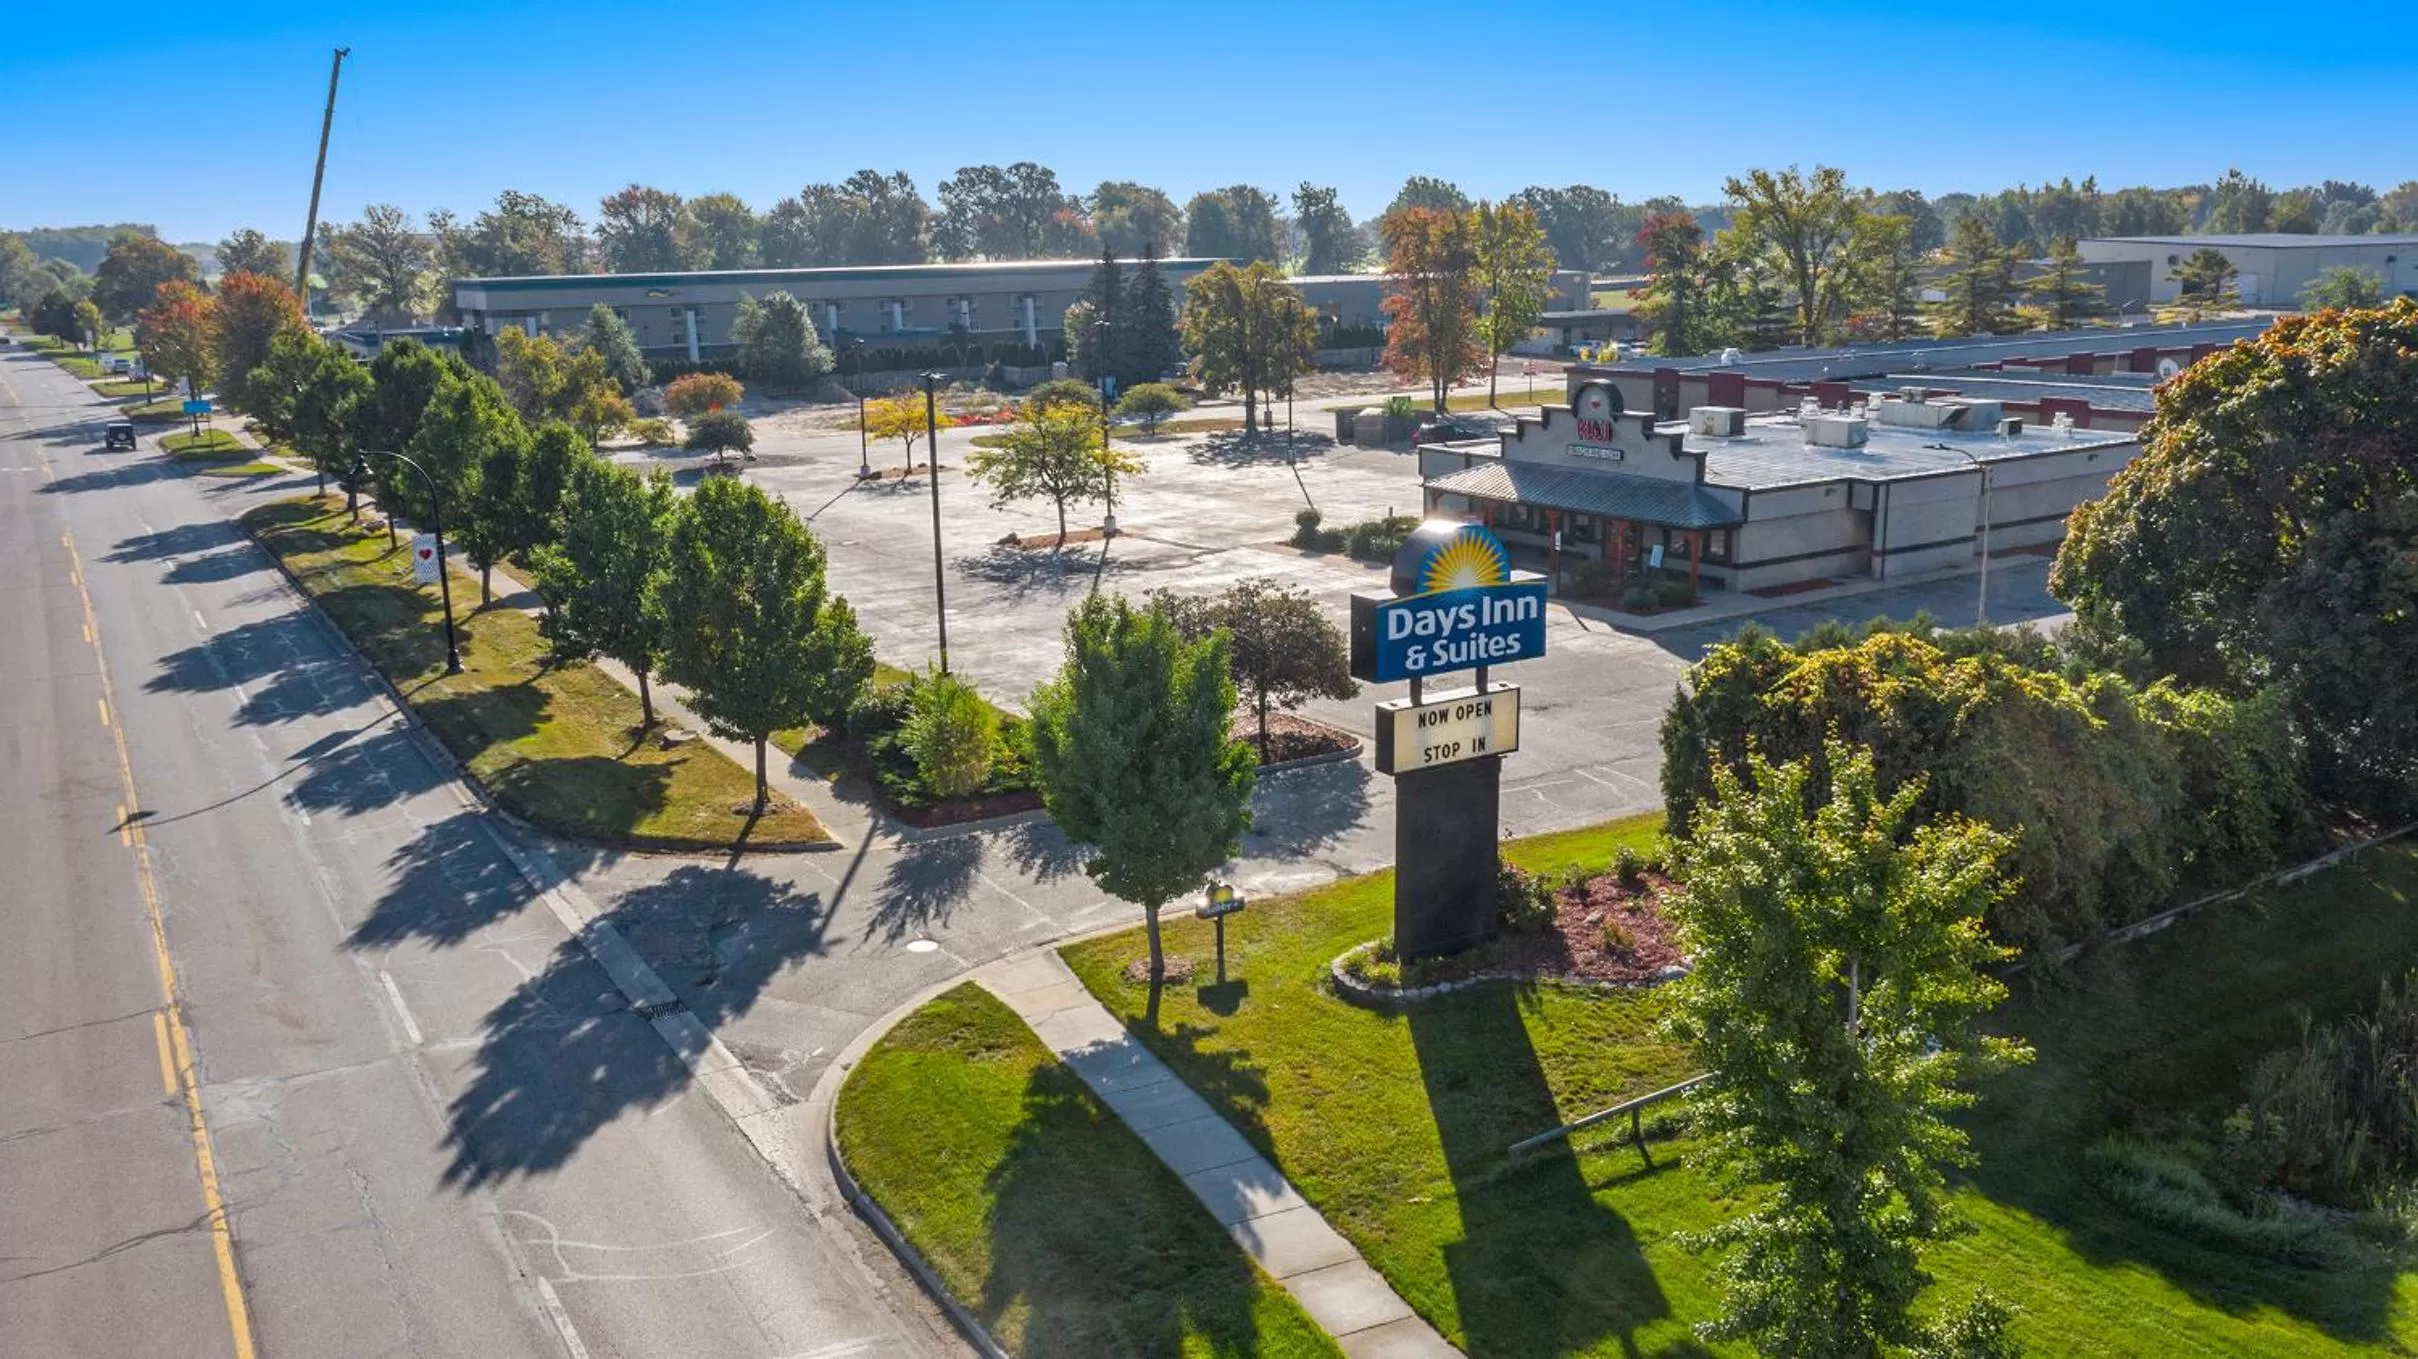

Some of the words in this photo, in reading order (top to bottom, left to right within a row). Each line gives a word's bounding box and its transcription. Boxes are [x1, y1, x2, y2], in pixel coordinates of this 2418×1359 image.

[1388, 604, 1476, 640] Days
[1482, 596, 1538, 626] Inn
[1405, 645, 1427, 670] &
[1432, 632, 1521, 667] Suites
[1418, 707, 1449, 728] NOW
[1456, 700, 1492, 720] OPEN
[1424, 742, 1460, 763] STOP
[1472, 736, 1486, 752] IN
